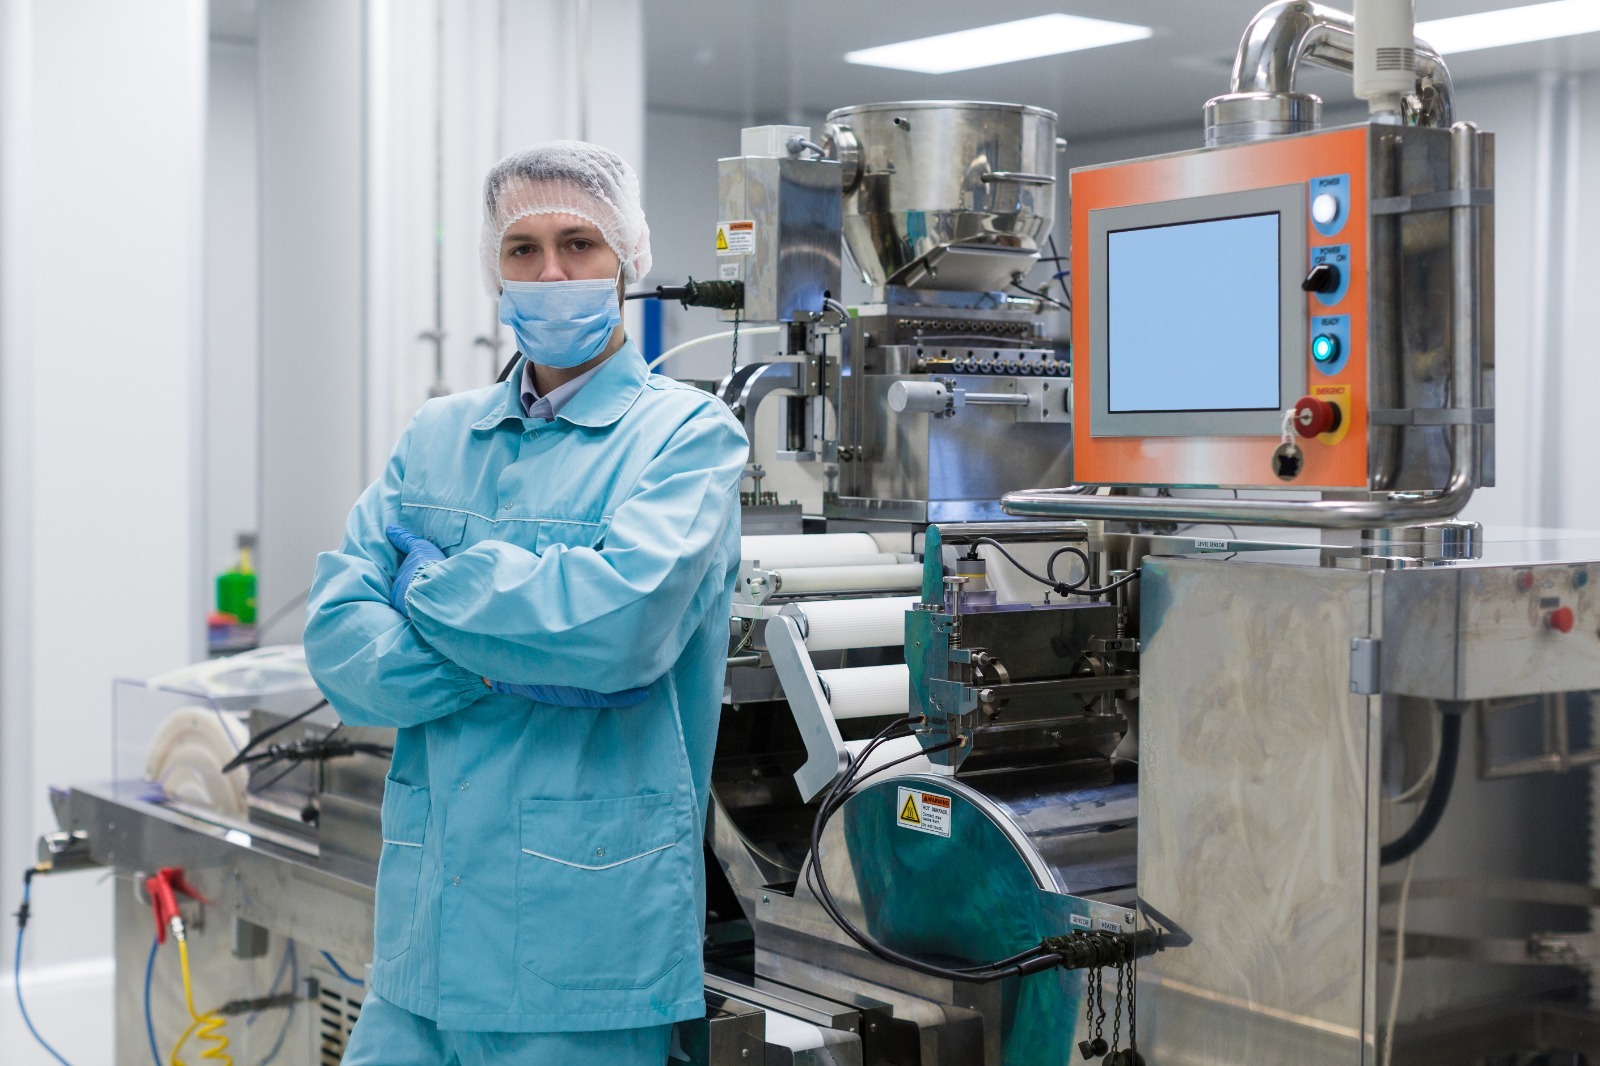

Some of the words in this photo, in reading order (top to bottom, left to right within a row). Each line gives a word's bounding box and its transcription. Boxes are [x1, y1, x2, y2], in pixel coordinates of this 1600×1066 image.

[1319, 177, 1340, 187] POWER
[1320, 246, 1340, 254] POWER
[1321, 317, 1339, 326] READY
[928, 796, 950, 806] WARNING
[1102, 922, 1117, 930] HEATER
